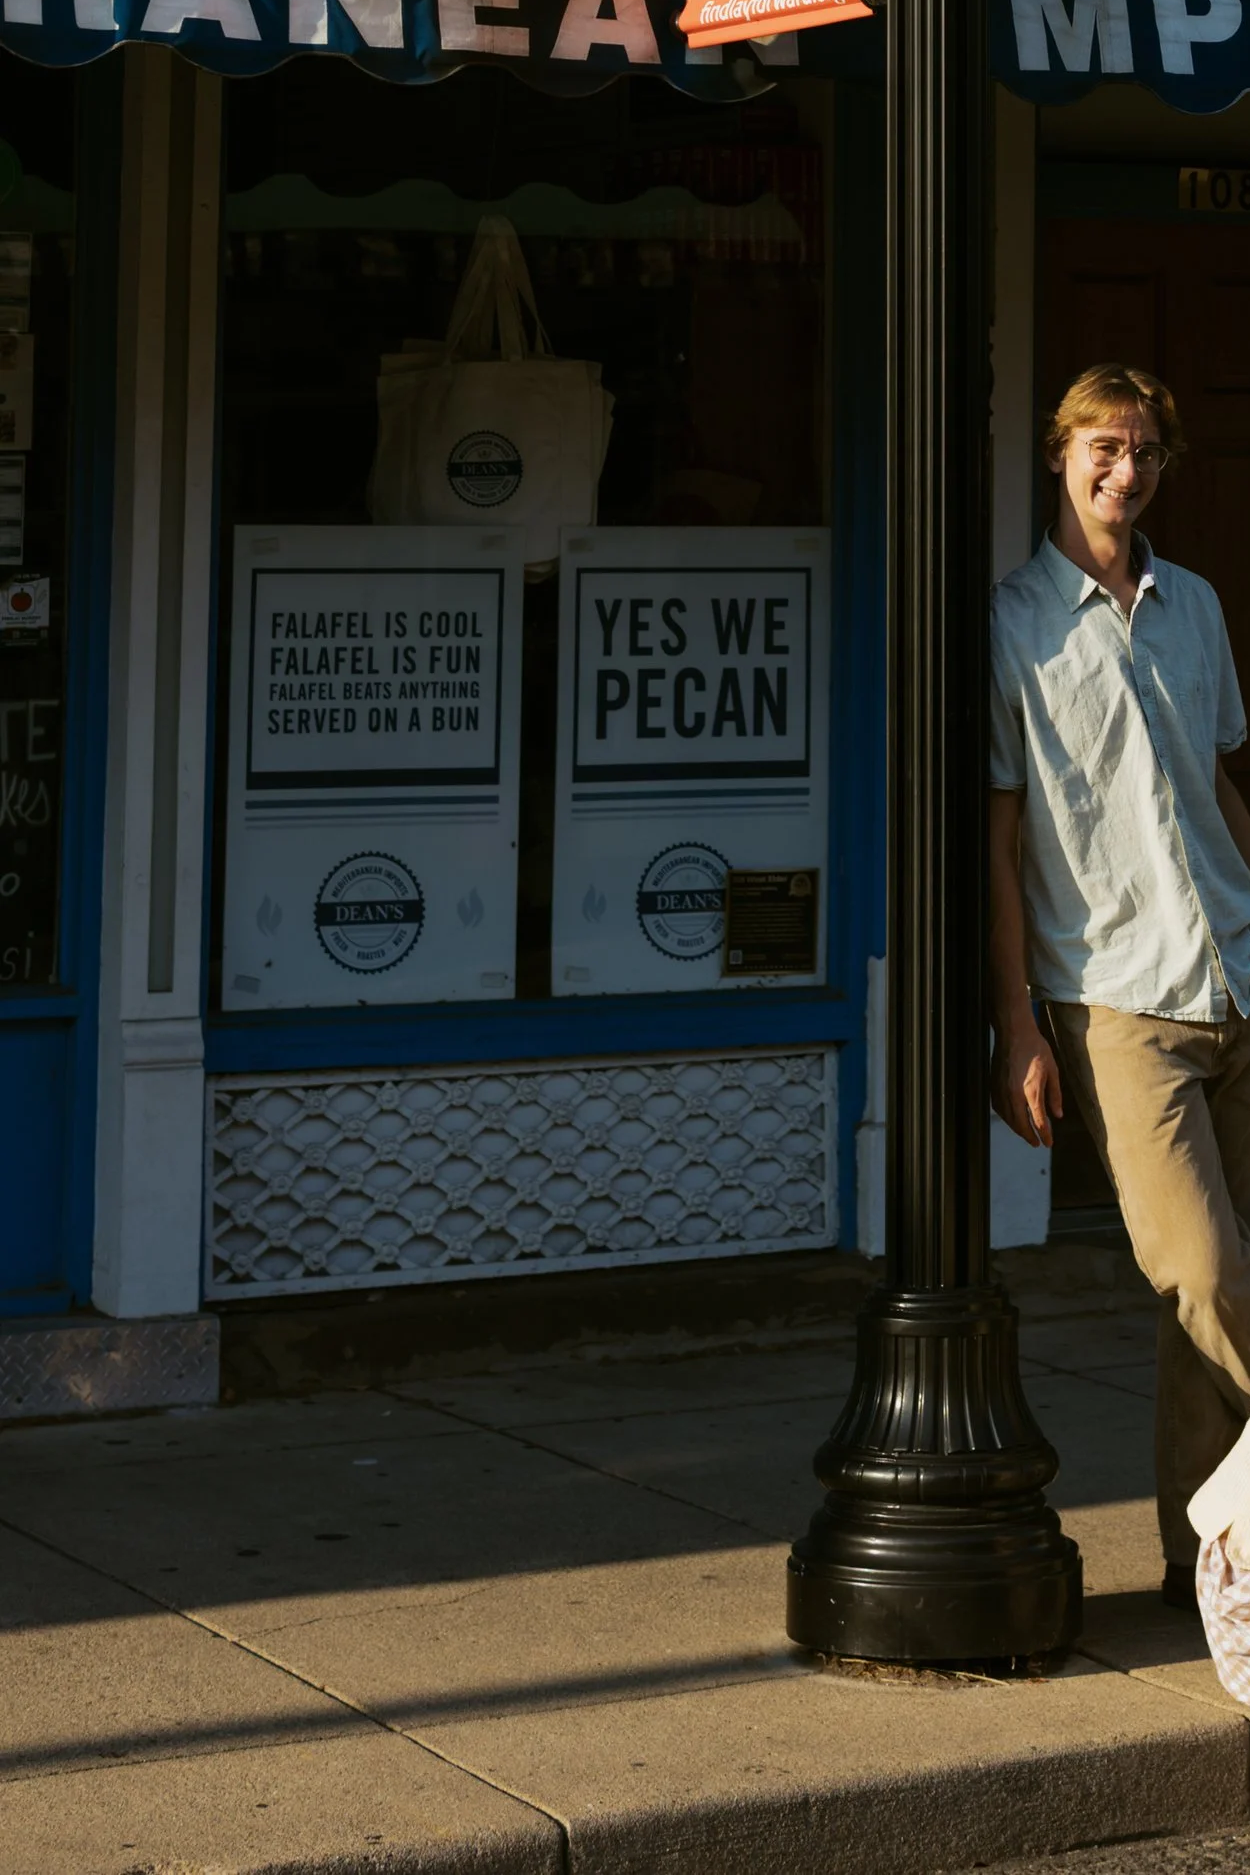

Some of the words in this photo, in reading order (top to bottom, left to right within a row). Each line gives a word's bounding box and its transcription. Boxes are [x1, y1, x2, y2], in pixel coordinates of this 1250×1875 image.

[271, 612, 373, 639] FALAFEL
[385, 611, 408, 638] IS
[419, 611, 483, 638] COOL
[595, 598, 687, 656] YES
[711, 598, 789, 655] WE
[270, 647, 379, 675] FALAFEL
[393, 646, 417, 674] IS
[429, 646, 480, 674] FUN
[269, 682, 336, 701] FALAFEL
[343, 682, 392, 700] BEATS
[399, 681, 480, 700] ANYTHING
[596, 667, 787, 740] PECAN
[268, 708, 356, 734] SERVED
[368, 707, 397, 732] ON
[408, 707, 421, 732] A
[432, 706, 479, 732] BUN
[335, 903, 405, 923] DEAN'S
[656, 893, 722, 912] DEAN'S
